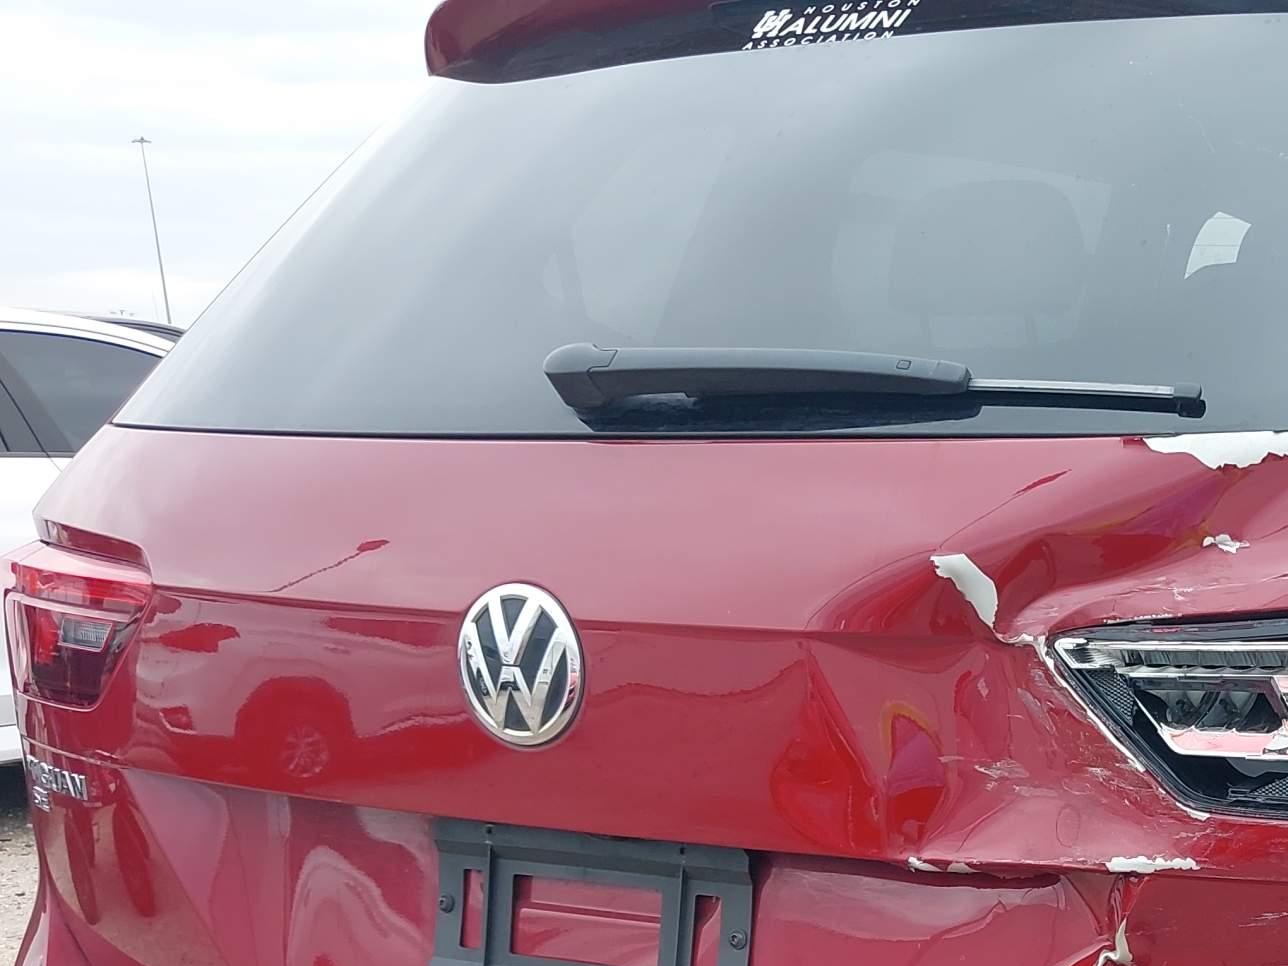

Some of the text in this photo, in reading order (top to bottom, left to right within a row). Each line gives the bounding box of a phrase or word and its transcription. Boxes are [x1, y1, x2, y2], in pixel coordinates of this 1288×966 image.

[804, 0, 920, 14] HOUSTON
[779, 9, 911, 36] ALUMNI
[742, 31, 894, 50] ASSOCIATION
[462, 584, 578, 742] VW
